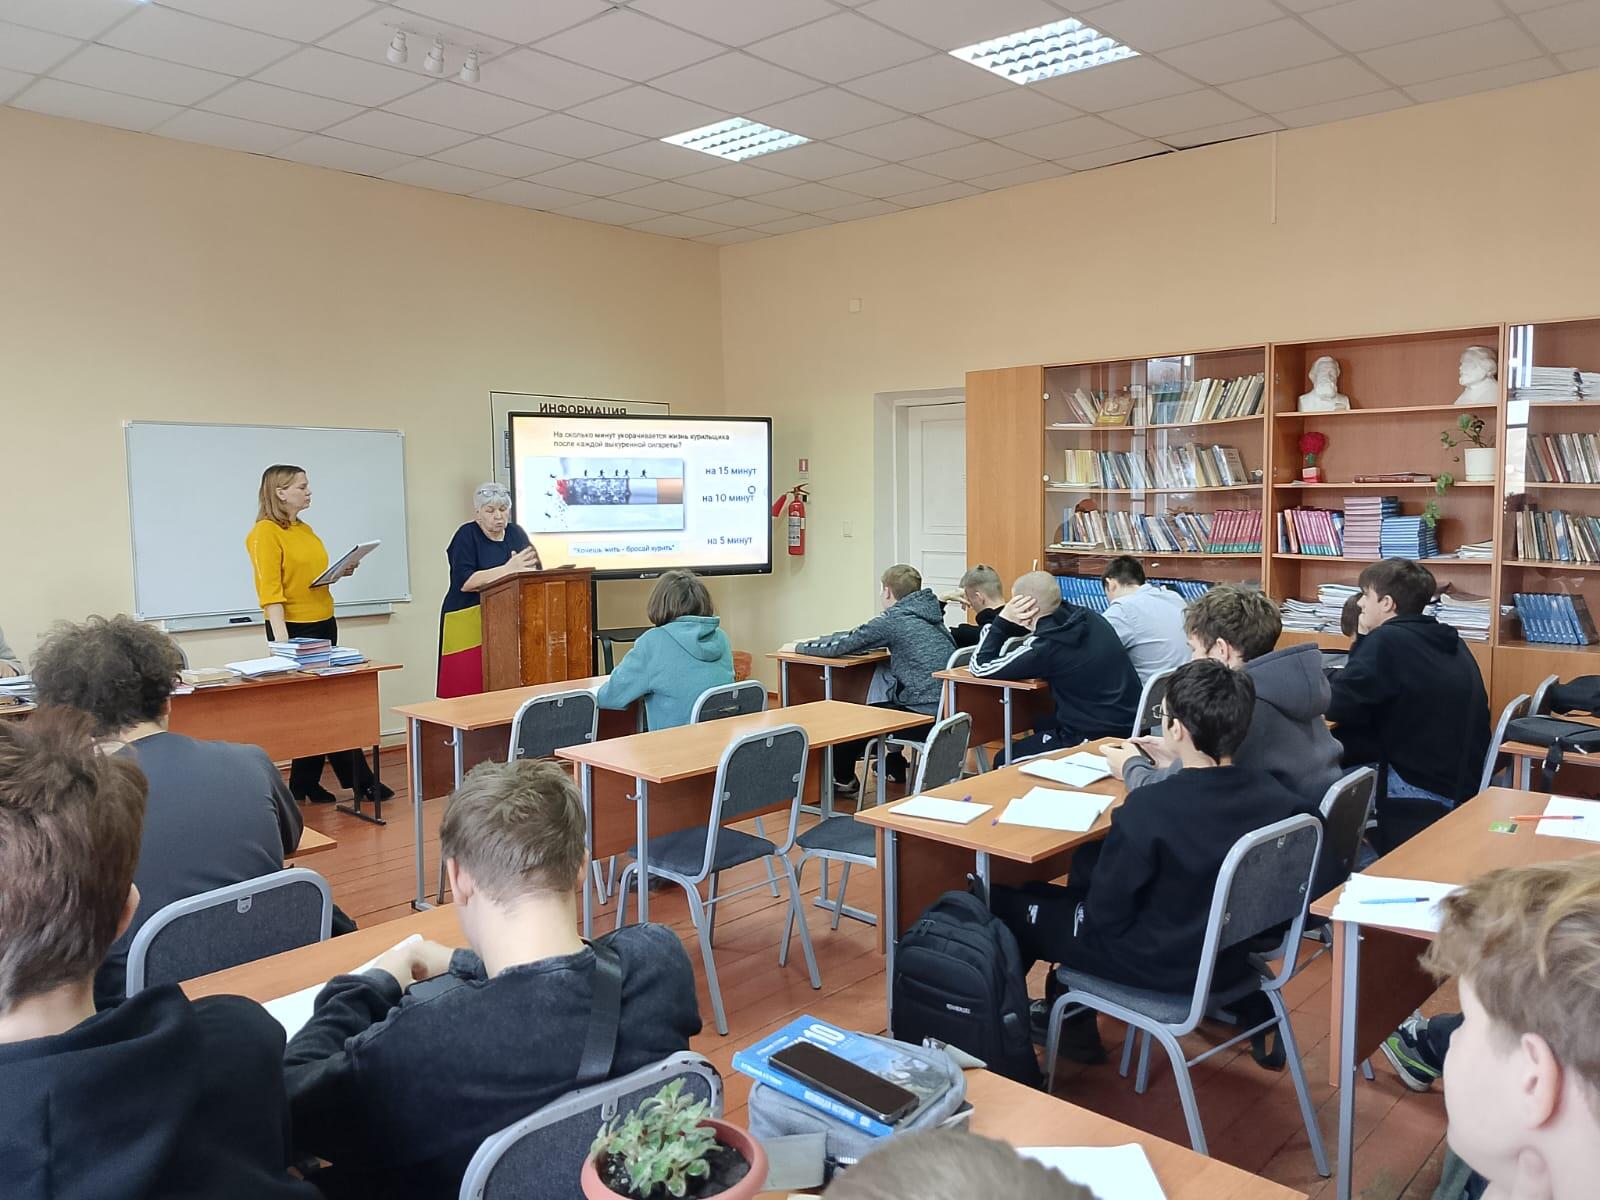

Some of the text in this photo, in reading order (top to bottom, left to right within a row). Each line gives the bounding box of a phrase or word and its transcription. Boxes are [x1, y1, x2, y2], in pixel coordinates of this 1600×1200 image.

[540, 403, 627, 415] ИНФОРМАЦИЯ
[605, 441, 646, 449] выкуренной
[719, 466, 729, 475] 15
[731, 468, 757, 477] минут
[715, 493, 727, 502] 10
[729, 495, 755, 503] минут
[720, 536, 725, 545] 5
[727, 537, 752, 546] минут
[626, 545, 650, 553] бросай
[803, 1023, 846, 1046] 10
